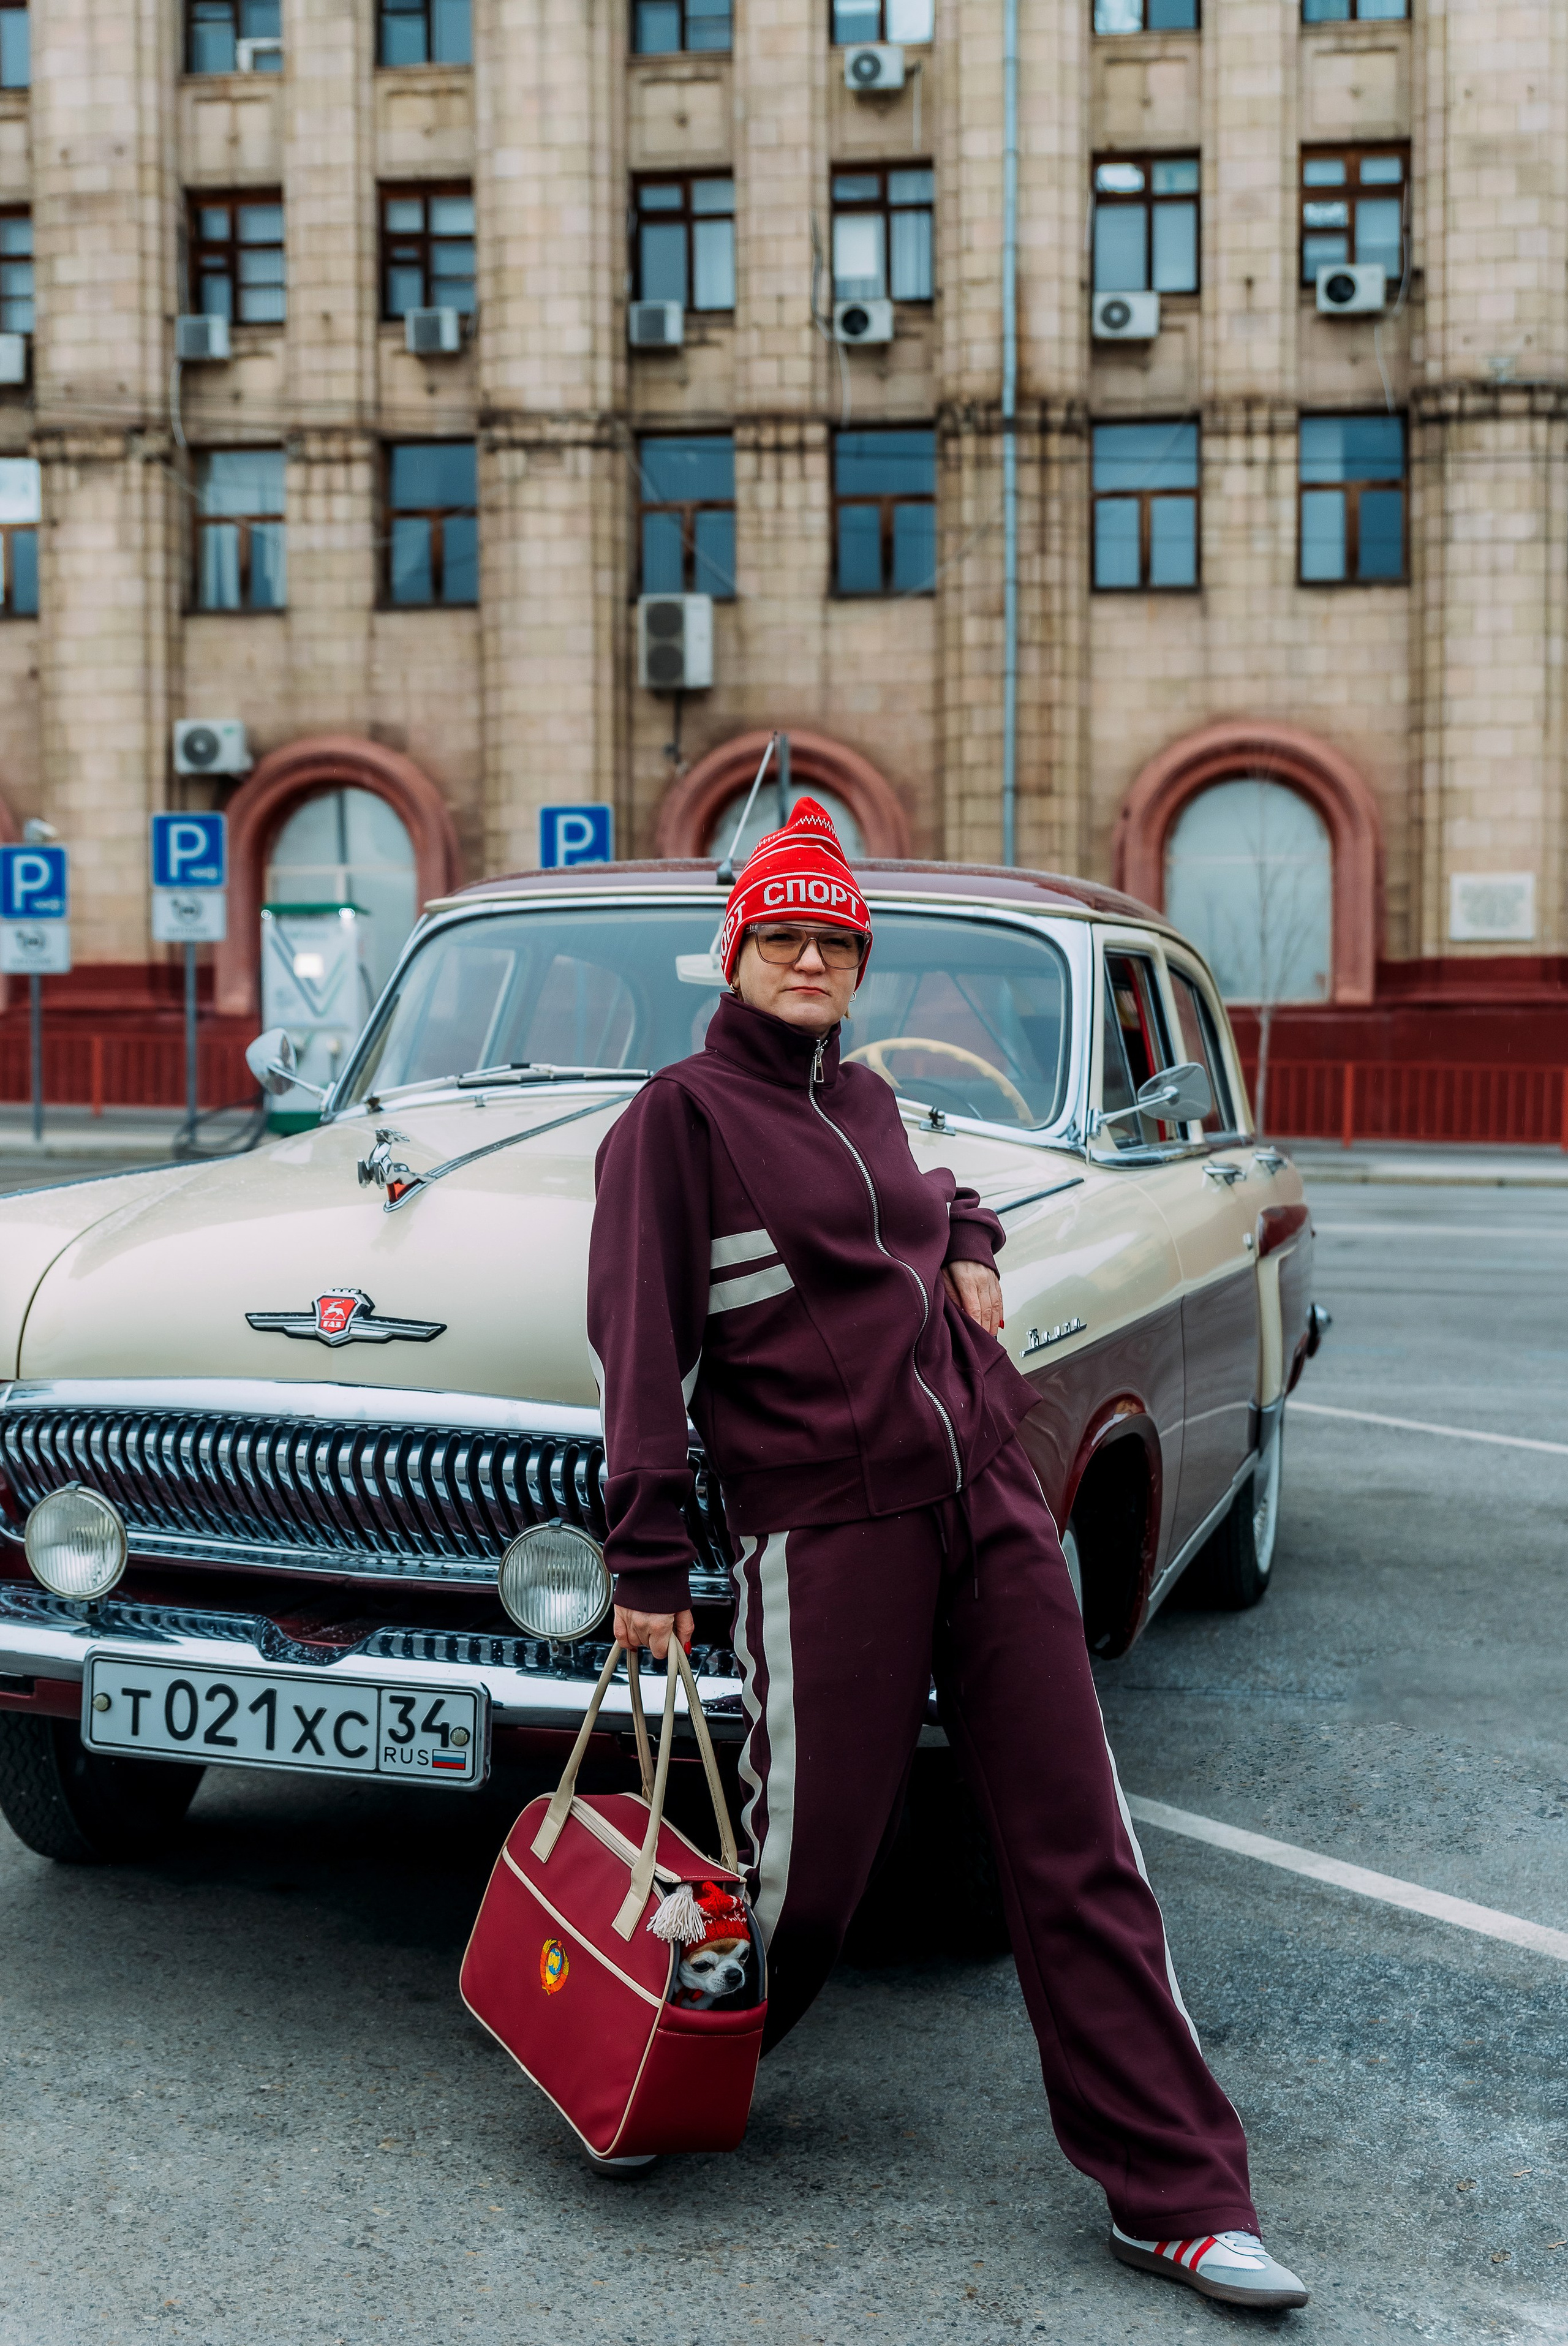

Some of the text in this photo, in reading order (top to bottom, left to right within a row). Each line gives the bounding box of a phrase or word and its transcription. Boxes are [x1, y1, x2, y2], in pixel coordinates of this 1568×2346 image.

[169, 823, 208, 878] P
[557, 815, 593, 866] P
[12, 855, 51, 910] P
[764, 879, 859, 916] СПОРТ
[720, 900, 746, 966] ОРТ
[388, 1695, 450, 1748] 34
[384, 1746, 429, 1766] RUS
